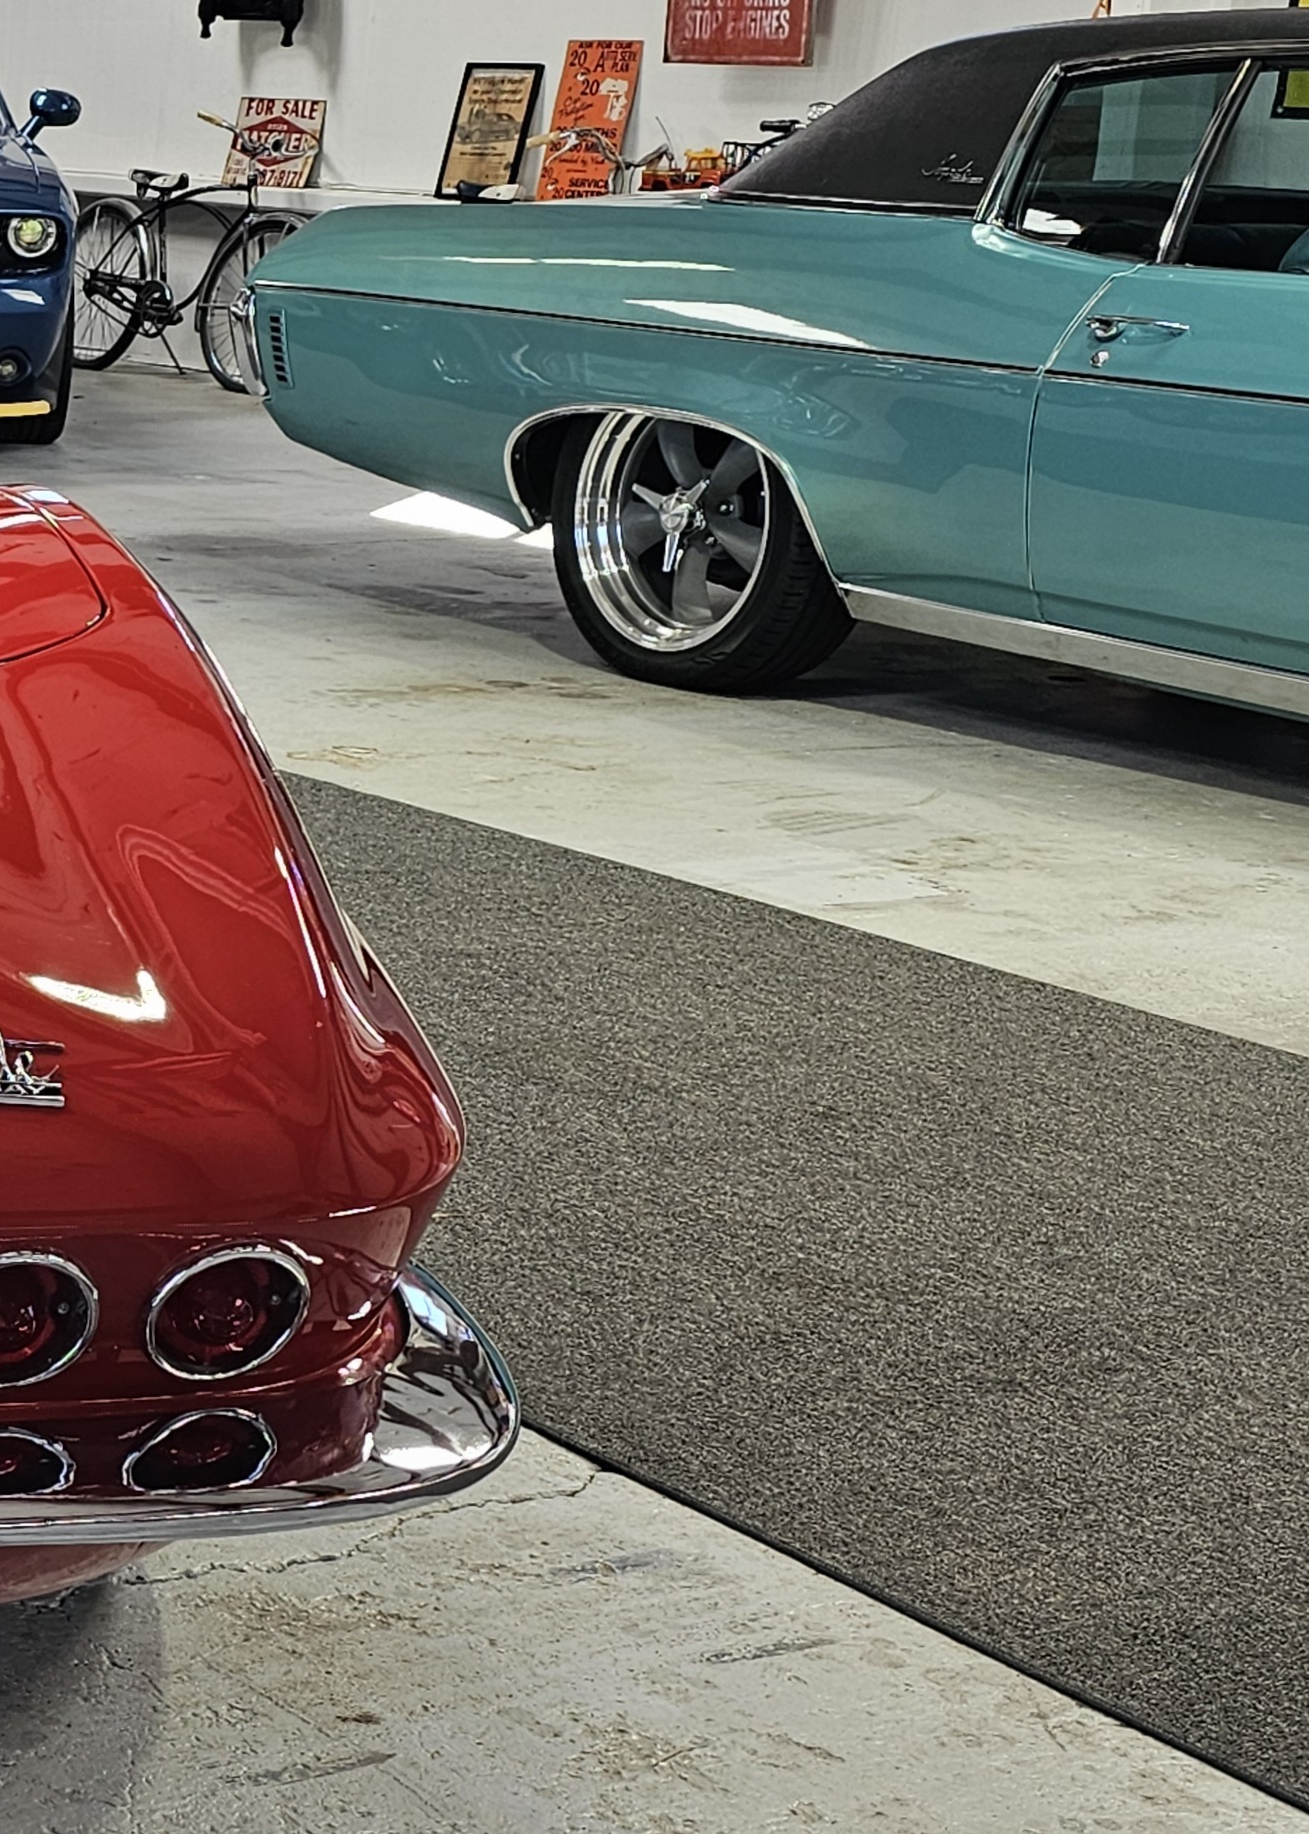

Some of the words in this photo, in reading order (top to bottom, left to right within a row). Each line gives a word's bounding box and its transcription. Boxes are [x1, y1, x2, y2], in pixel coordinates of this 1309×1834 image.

[685, 10, 723, 39] STOP
[725, 10, 790, 40] ENGINES
[569, 50, 588, 67] 20
[580, 79, 600, 97] 20
[245, 98, 276, 118] FOR
[281, 99, 319, 120] SALE
